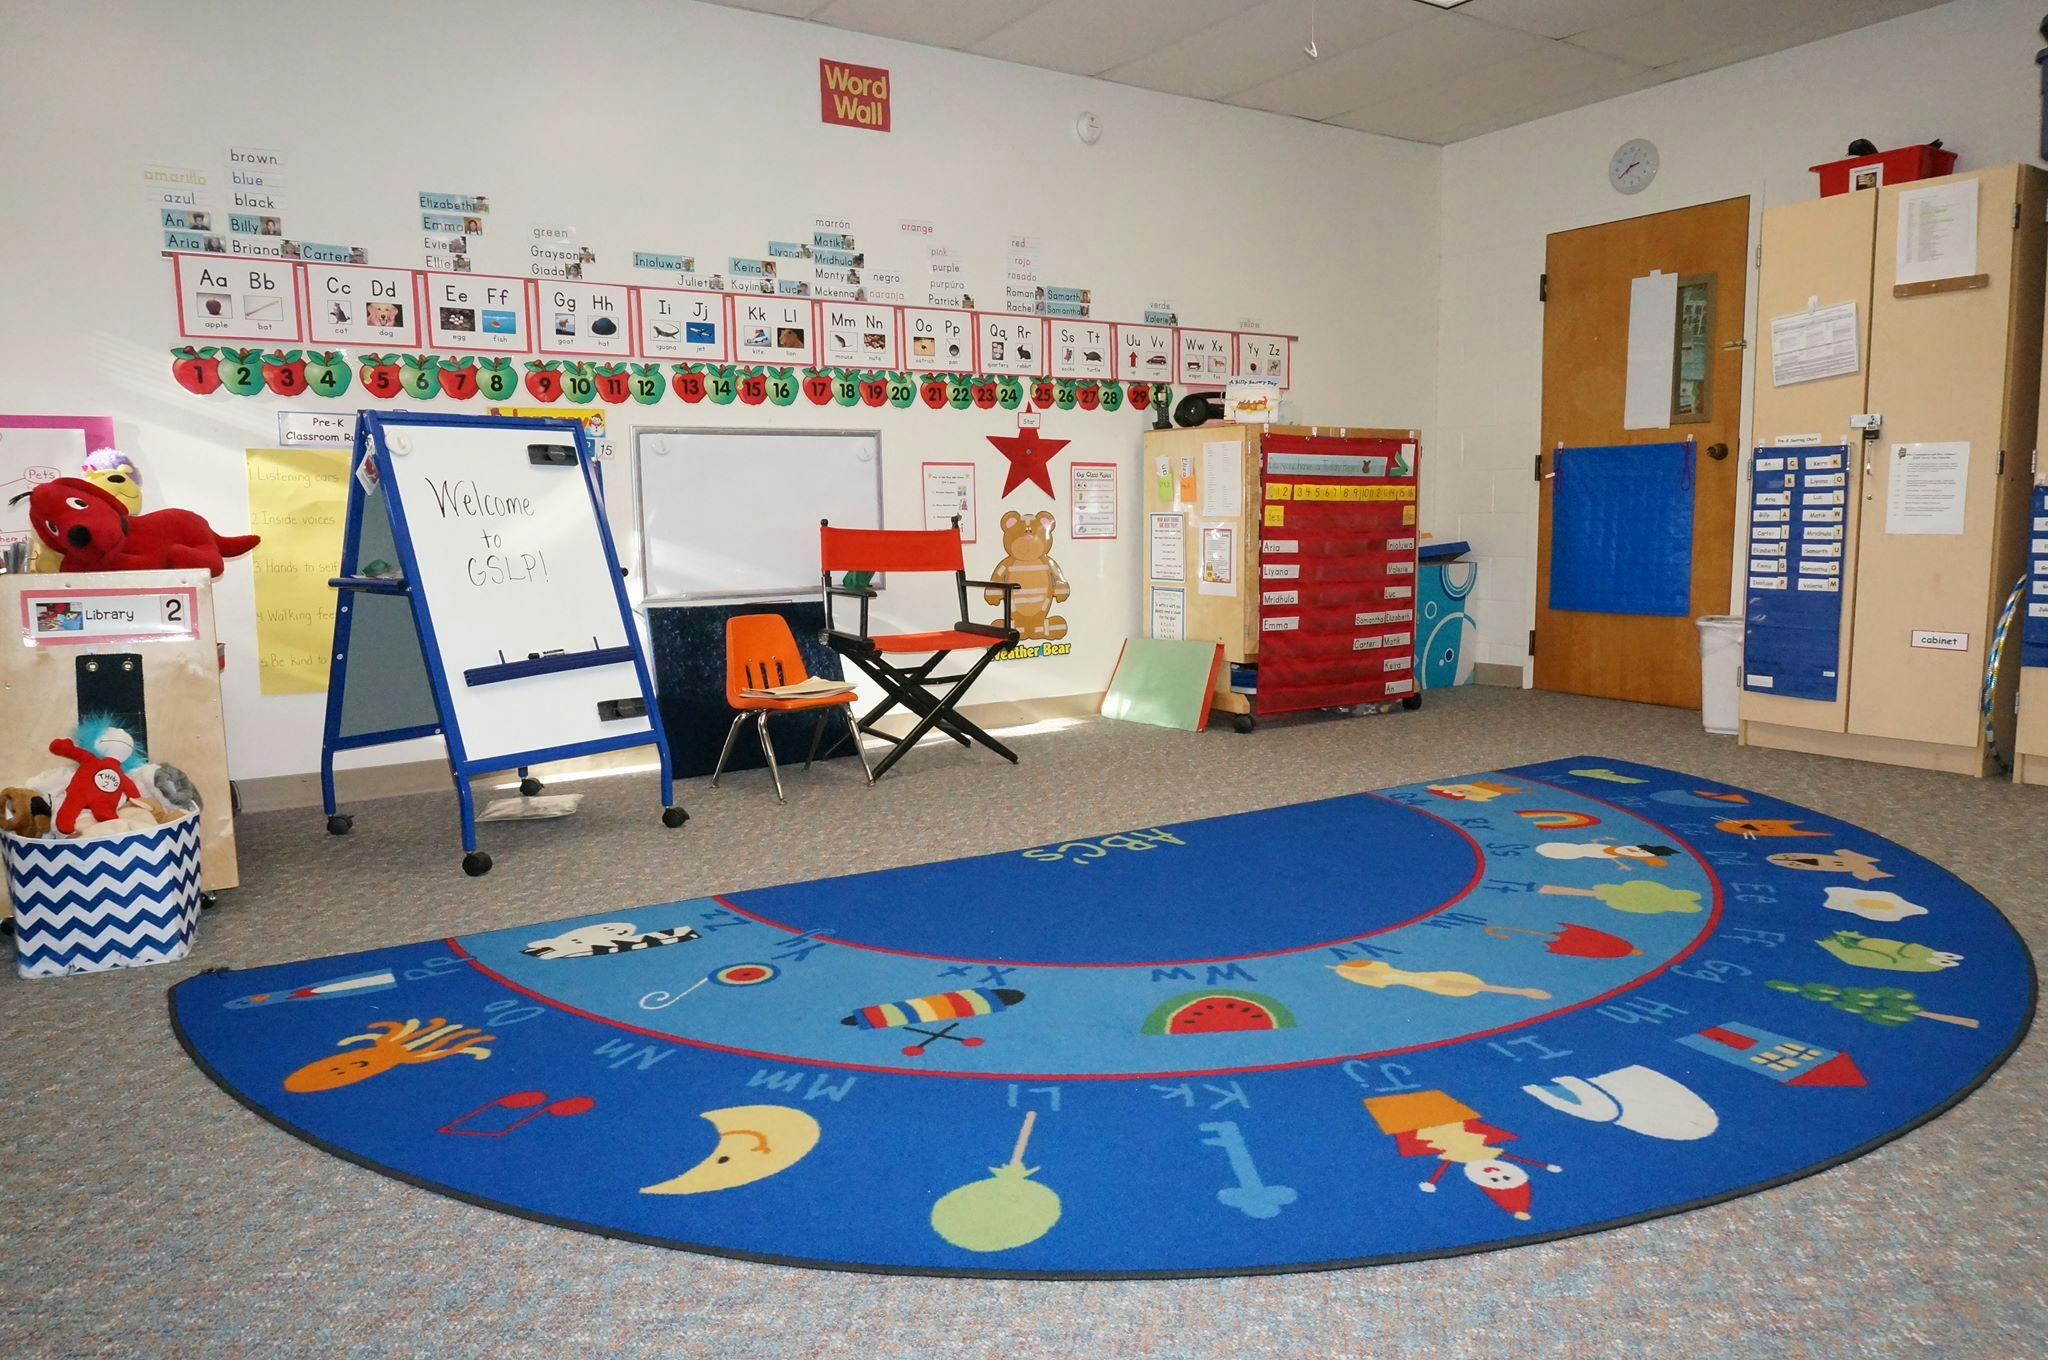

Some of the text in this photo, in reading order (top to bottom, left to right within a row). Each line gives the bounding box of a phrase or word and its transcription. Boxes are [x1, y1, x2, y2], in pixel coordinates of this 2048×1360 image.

[824, 64, 887, 100] Word
[833, 94, 882, 126] Wall
[230, 149, 277, 165] brown
[144, 170, 206, 185] amarillo
[232, 172, 263, 186] blue
[164, 192, 195, 205] azul
[235, 193, 274, 209] black
[420, 197, 473, 212] Elizabeth
[165, 213, 184, 227] An
[231, 218, 259, 235] Billy
[424, 217, 464, 232] Emma
[816, 217, 850, 229] marrón
[533, 227, 567, 238] green
[902, 223, 933, 234] orange
[168, 234, 200, 249] Aria
[232, 240, 280, 257] Briana
[424, 237, 447, 249] Evie
[814, 236, 841, 248] Matik
[1012, 238, 1025, 248] red
[303, 246, 349, 262] Carter
[531, 245, 579, 261] Grayson
[769, 245, 799, 259] Liyana
[815, 252, 853, 266] Mridhula
[931, 248, 947, 257] pink
[426, 255, 451, 269] Ellie
[635, 255, 681, 269] Inioluwa
[734, 260, 761, 274] Keira
[932, 263, 960, 273] purple
[1015, 257, 1031, 268] rojo
[531, 263, 565, 276] Giada
[816, 268, 845, 282] Monty
[1008, 271, 1037, 282] rosado
[200, 269, 275, 291] Aa Bb
[678, 275, 708, 288] Juliet
[732, 279, 759, 292] Kaylin
[873, 273, 900, 284] negro
[326, 277, 396, 297] Cc Dd
[815, 286, 855, 298] Mckenna
[1007, 286, 1034, 299] Roman
[445, 285, 509, 305] Ee Ff
[554, 291, 613, 312] Gg Hh
[870, 290, 904, 301] naranja
[928, 294, 959, 306] Patrick
[1047, 290, 1080, 301] Samarth
[658, 300, 708, 321] Ii Jj
[748, 306, 797, 322] Kk Ll
[1007, 301, 1034, 313] Rachel
[1047, 305, 1082, 316] Samantha
[832, 313, 883, 329] Mm Nn
[1145, 312, 1168, 324] Valerie
[204, 320, 272, 331] apple bat
[915, 318, 960, 337] Oo Pp
[990, 324, 1031, 340] Qq Rr
[378, 329, 394, 338] dog
[1061, 329, 1100, 344] Ss Tt
[558, 338, 574, 346] goat
[1126, 334, 1164, 348] Uu Vv
[1186, 338, 1223, 352] Ww Xx
[1247, 342, 1280, 357] Yy Zz
[194, 365, 1146, 404] 1 2 3 4 5 6 7 8 9 10 11 12 13 14 15 16 17 18 19 20 21 22 23 24 25 26 27 28 29
[313, 418, 344, 427] Pre-K
[286, 432, 340, 442] Classroom
[600, 444, 613, 456] 15
[29, 470, 55, 479] Pets
[257, 466, 339, 488] Listening ears
[425, 477, 534, 518] Welcome
[262, 514, 335, 525] Inside voices
[480, 529, 501, 549] to
[1264, 542, 1280, 551] Aria
[266, 561, 338, 574] Hands self
[467, 551, 549, 586] GSLP!
[1264, 566, 1289, 576] Liyana
[1264, 594, 1295, 604] Mridhula
[85, 598, 182, 622] Library 2
[267, 607, 312, 626] Walking
[1264, 620, 1288, 630] Emma
[1354, 640, 1376, 649] Carter
[1921, 635, 1957, 646] cabinet
[991, 642, 1070, 661] eather Bear
[270, 653, 313, 667] Be kind
[98, 773, 119, 787] THING
[1022, 829, 1185, 864] ABC's
[936, 964, 1017, 986] Xx
[1151, 963, 1258, 985] Ww
[593, 1037, 675, 1071] Nn
[746, 1068, 857, 1102] Mm
[1008, 1084, 1061, 1112] Ll
[1150, 1081, 1251, 1110] Kk
